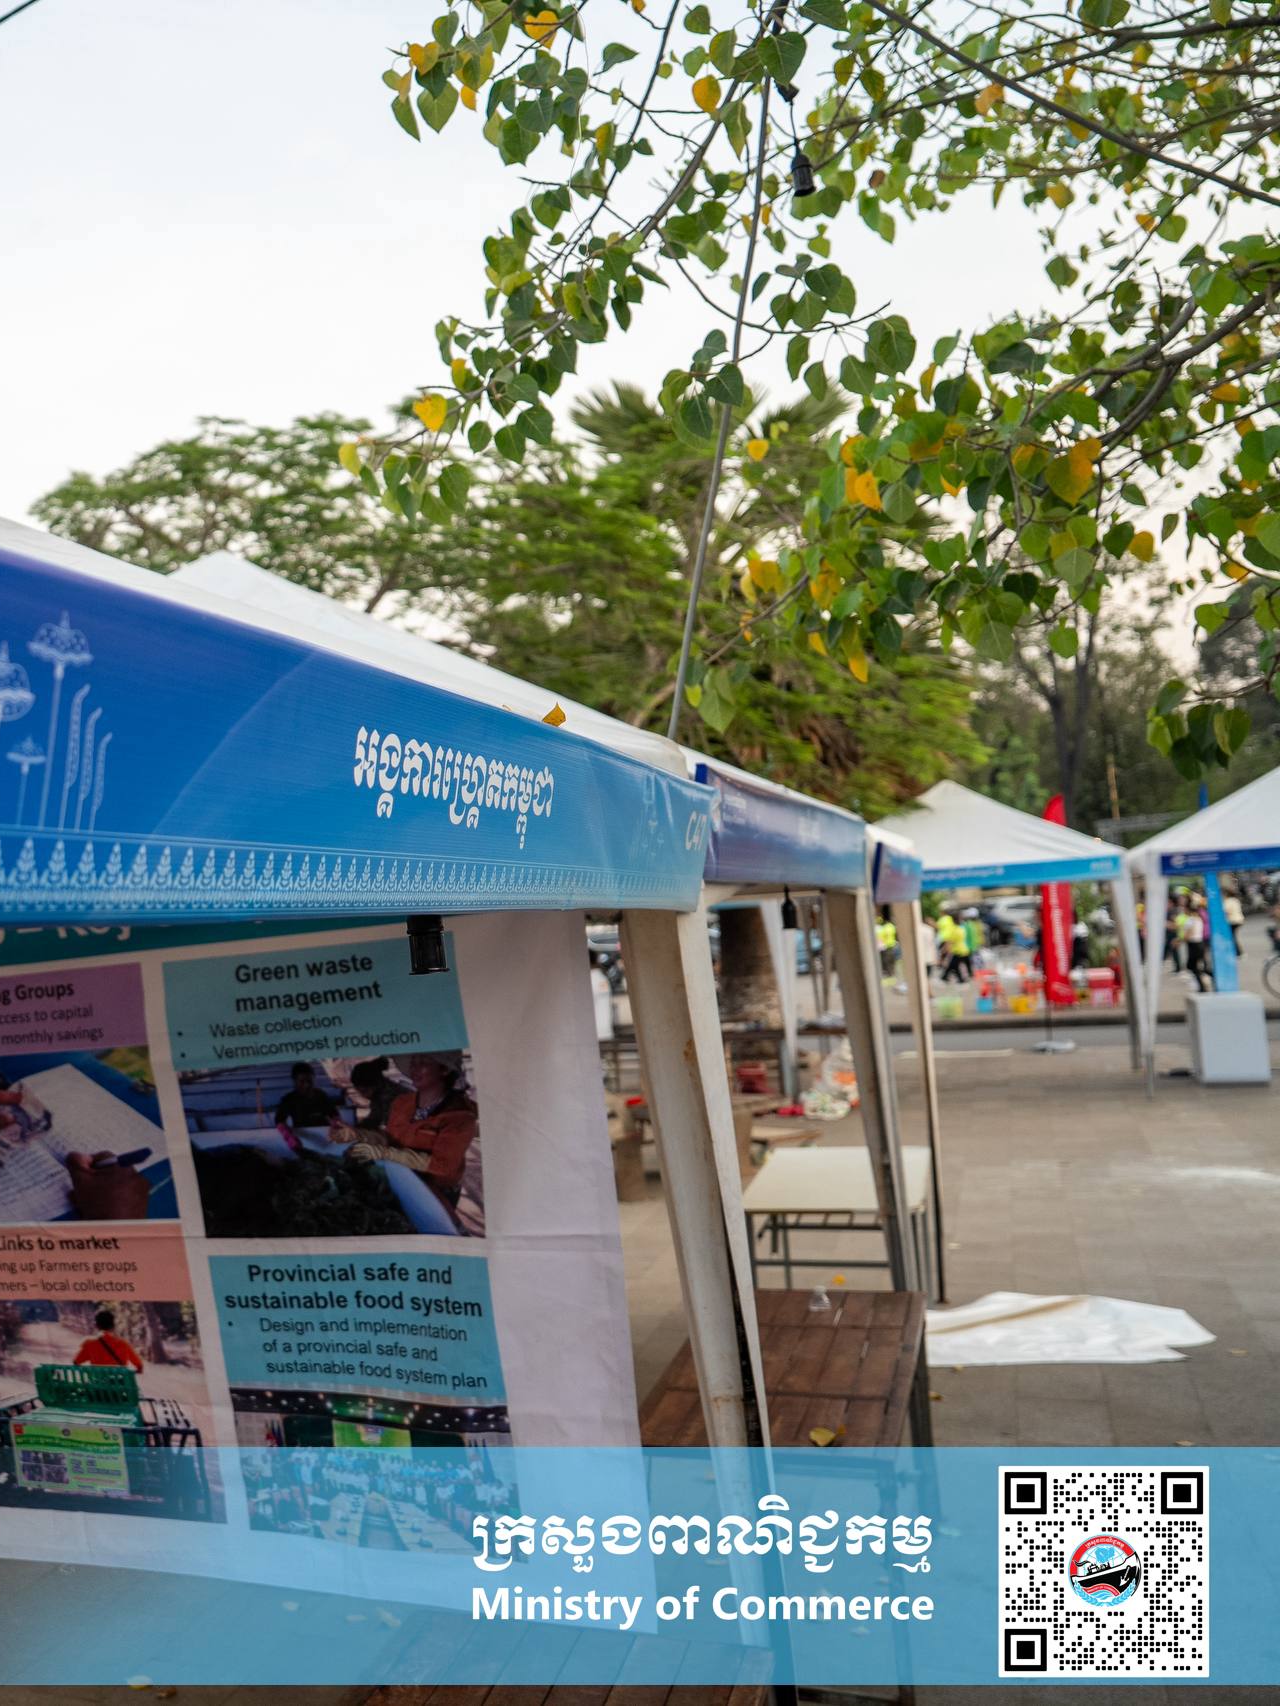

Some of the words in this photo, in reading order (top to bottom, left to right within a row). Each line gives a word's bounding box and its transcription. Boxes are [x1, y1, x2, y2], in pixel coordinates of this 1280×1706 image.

[235, 961, 300, 984] Green
[305, 954, 374, 977] waste
[15, 982, 75, 1001] Groups
[235, 981, 383, 1013] management
[34, 1008, 48, 1022] to
[51, 1005, 93, 1021] capital
[1, 1029, 54, 1047] monthly
[57, 1026, 104, 1042] savings
[209, 1023, 260, 1039] Waste
[264, 1013, 343, 1034] collection
[212, 1034, 330, 1060] Vermicompost
[334, 1029, 420, 1051] production
[37, 1237, 54, 1251] to
[59, 1235, 120, 1251] market
[20, 1262, 36, 1274] up
[39, 1259, 90, 1272] Farmers
[93, 1262, 138, 1274] groups
[247, 1264, 356, 1283] Provincial
[364, 1262, 410, 1282] safe
[417, 1266, 452, 1285] and
[41, 1279, 70, 1291] local
[73, 1279, 136, 1292] collectors
[224, 1290, 348, 1310] sustainable
[354, 1290, 405, 1310] food
[411, 1296, 483, 1318] system
[260, 1317, 315, 1335] Design
[320, 1317, 350, 1332] and
[354, 1318, 468, 1342] implementation
[262, 1339, 280, 1353] of
[282, 1343, 292, 1353] a
[297, 1340, 373, 1357] provincial
[376, 1342, 408, 1358] safe
[411, 1346, 438, 1362] and
[266, 1359, 356, 1376] sustainable
[359, 1360, 392, 1378] food
[396, 1366, 448, 1385] system
[451, 1369, 487, 1390] plan
